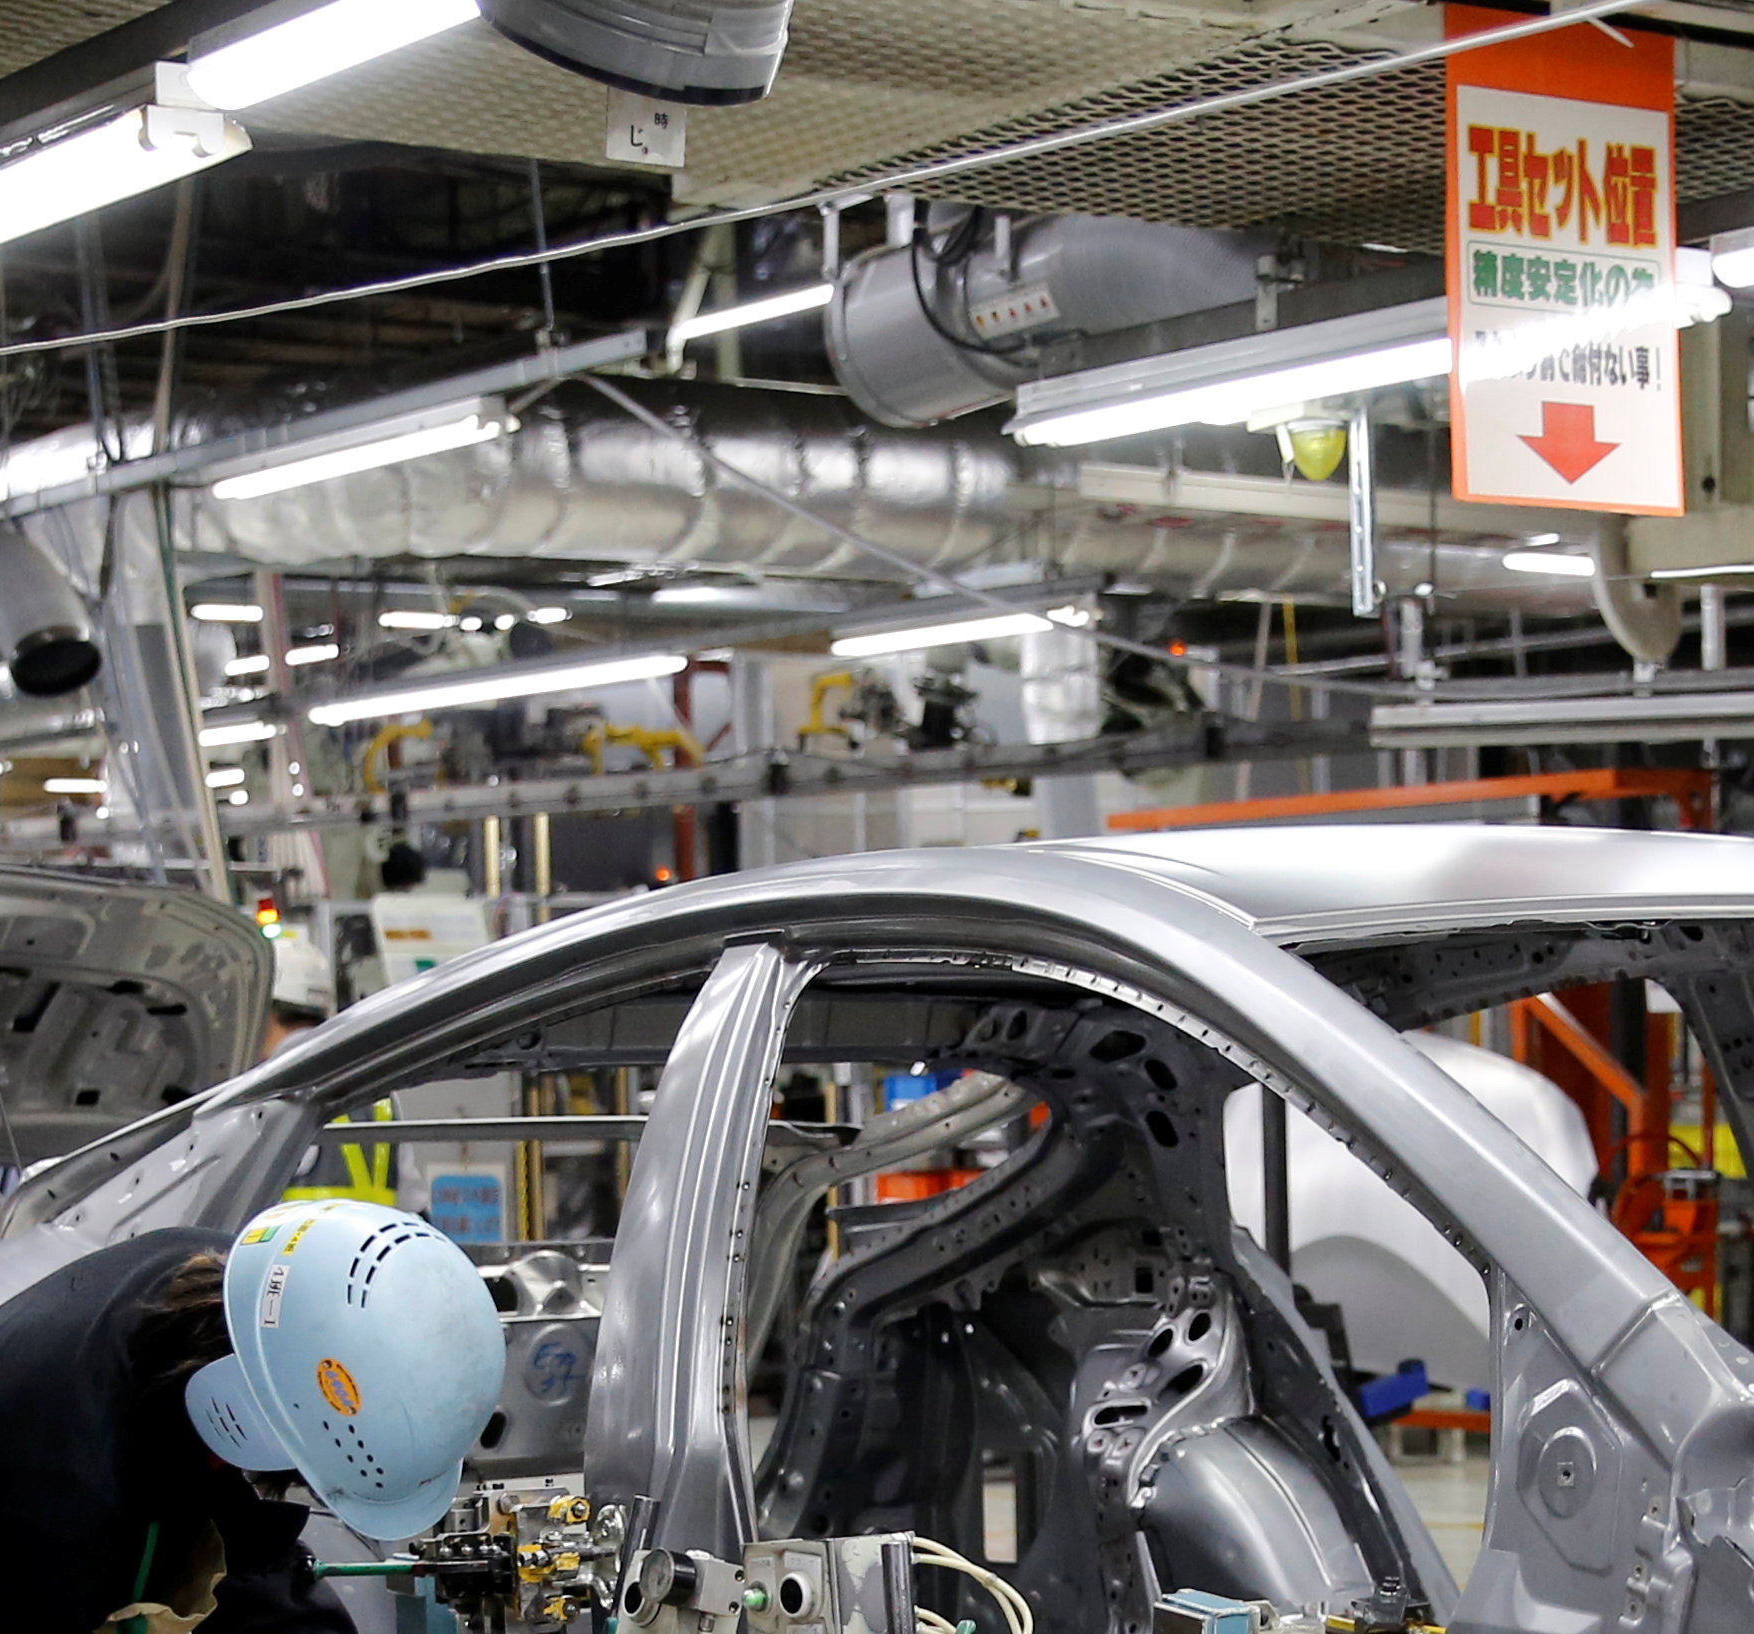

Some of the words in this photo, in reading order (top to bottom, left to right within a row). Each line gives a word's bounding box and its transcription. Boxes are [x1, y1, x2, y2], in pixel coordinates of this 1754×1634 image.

[1467, 124, 1659, 248] 工具セット位置
